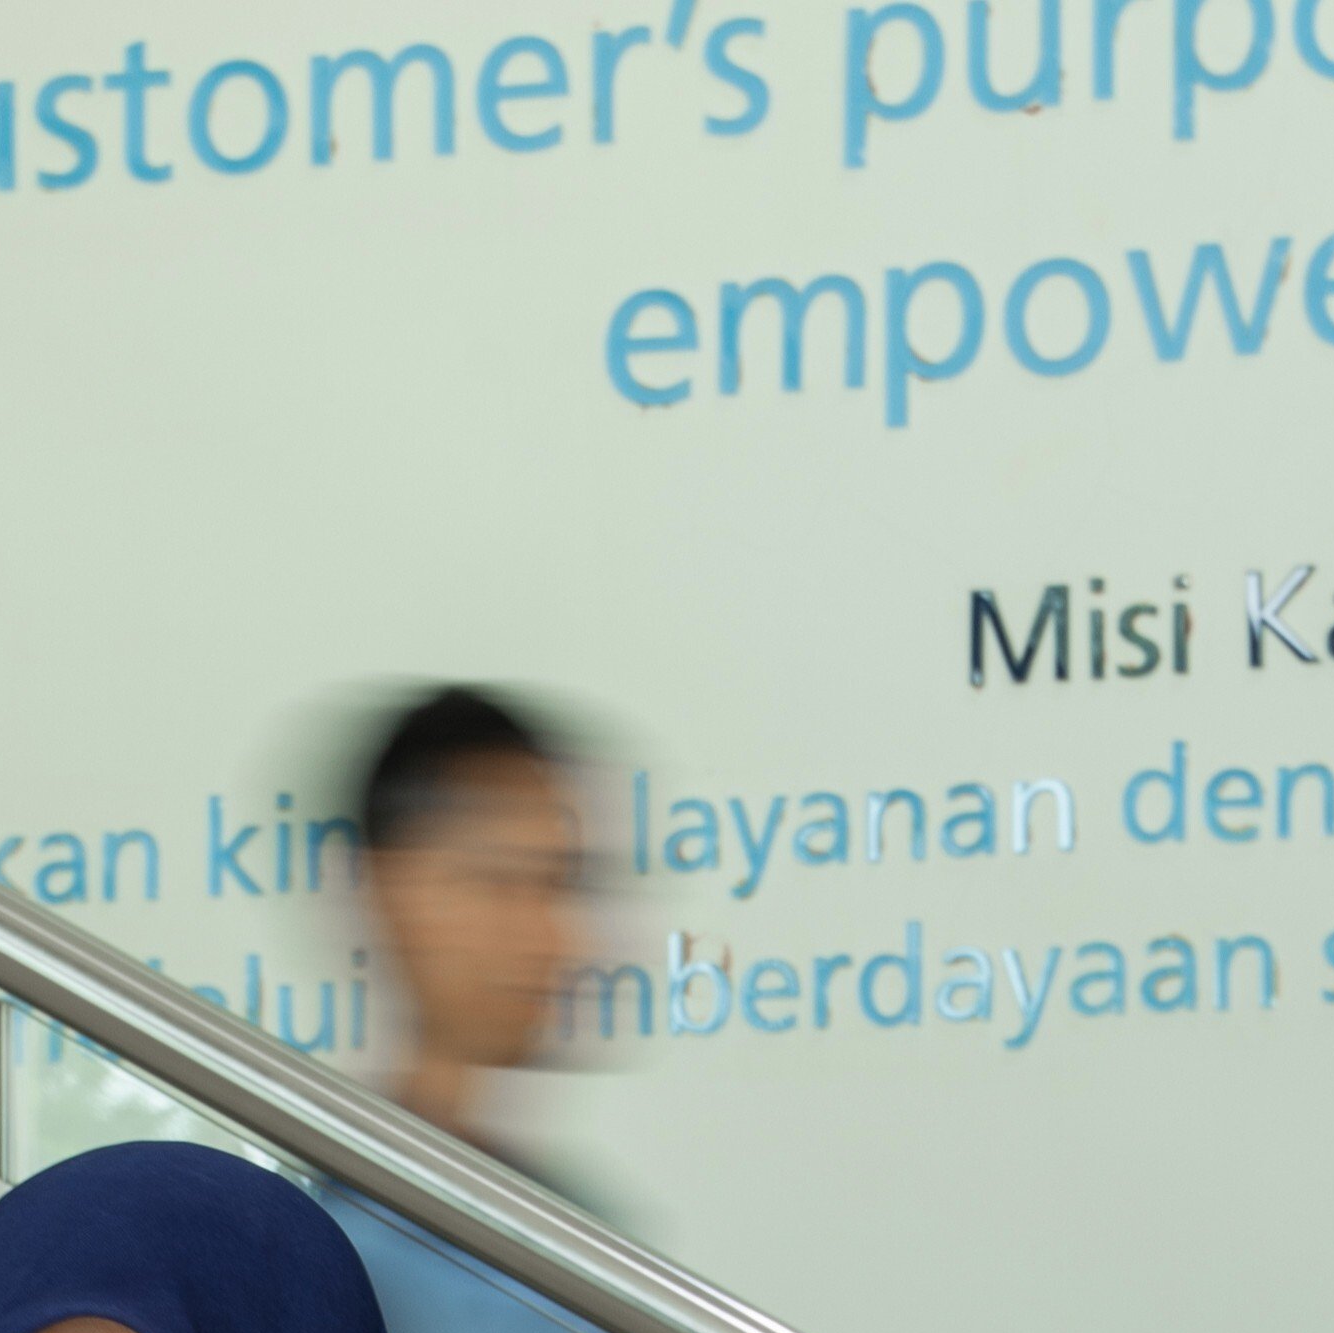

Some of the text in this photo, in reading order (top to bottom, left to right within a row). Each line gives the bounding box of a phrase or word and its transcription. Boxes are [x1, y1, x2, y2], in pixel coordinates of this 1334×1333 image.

[968, 574, 1194, 691] Misi
[633, 769, 1078, 898] layanan
[559, 920, 1282, 1052] mberdayaan
